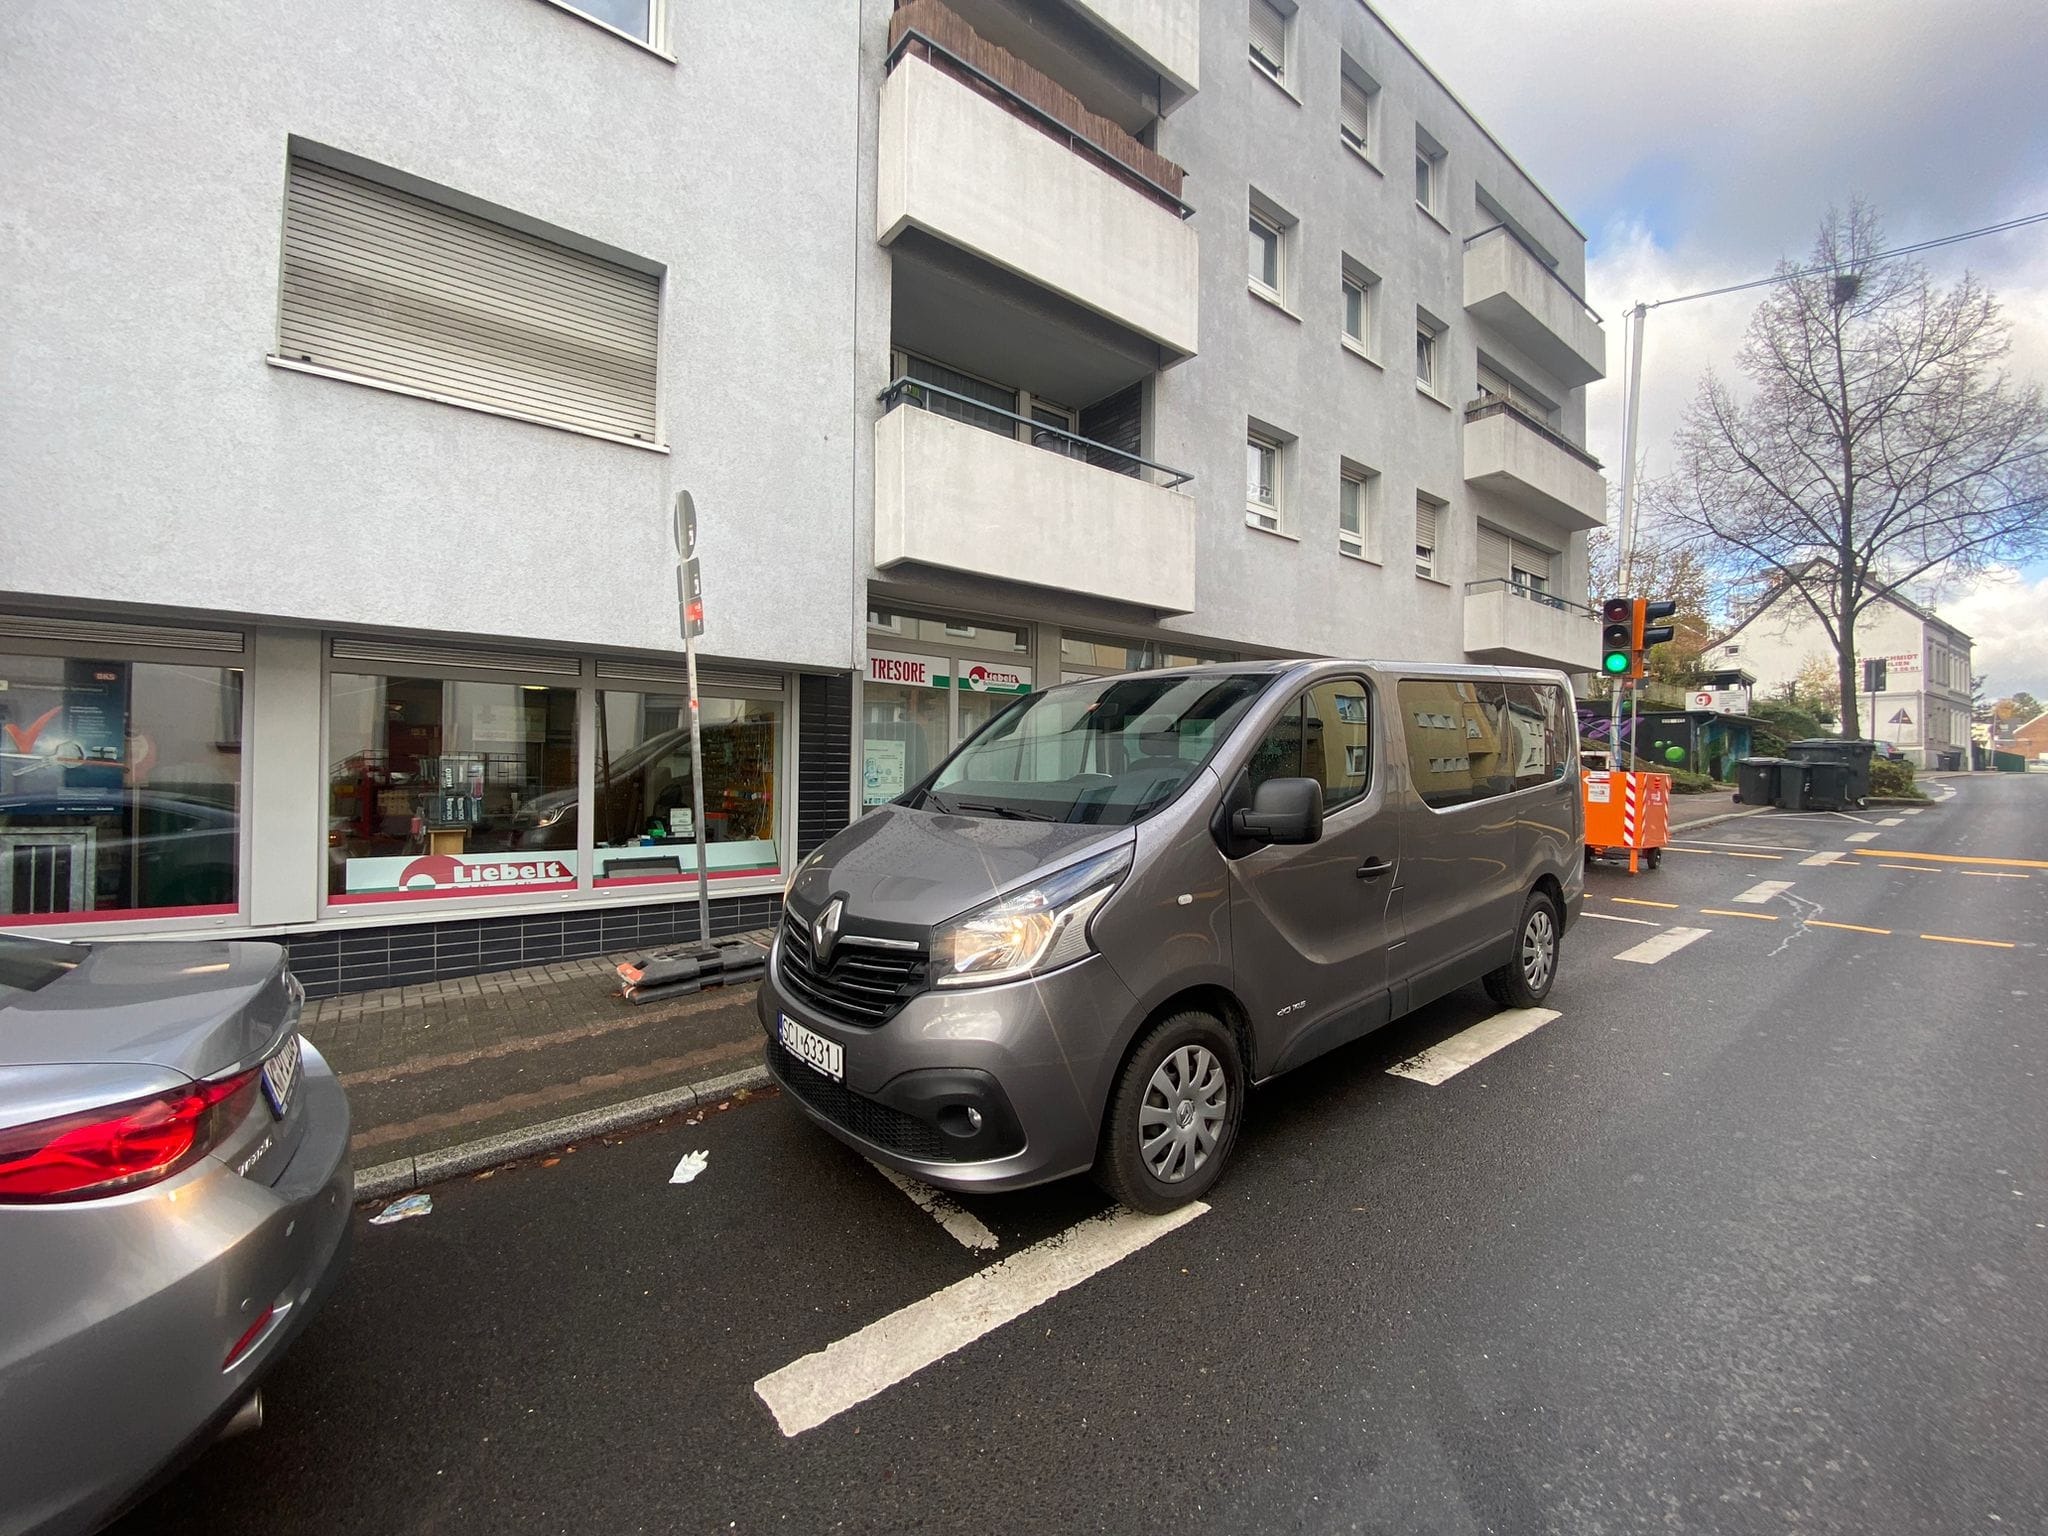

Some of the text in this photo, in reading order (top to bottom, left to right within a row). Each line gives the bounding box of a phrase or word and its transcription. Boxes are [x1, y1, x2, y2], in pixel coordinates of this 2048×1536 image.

[871, 657, 926, 683] TRESORE
[984, 671, 1017, 683] Liebelt
[453, 861, 560, 883] Liebelt
[783, 1018, 799, 1050] SCI
[803, 1033, 840, 1073] 6331J
